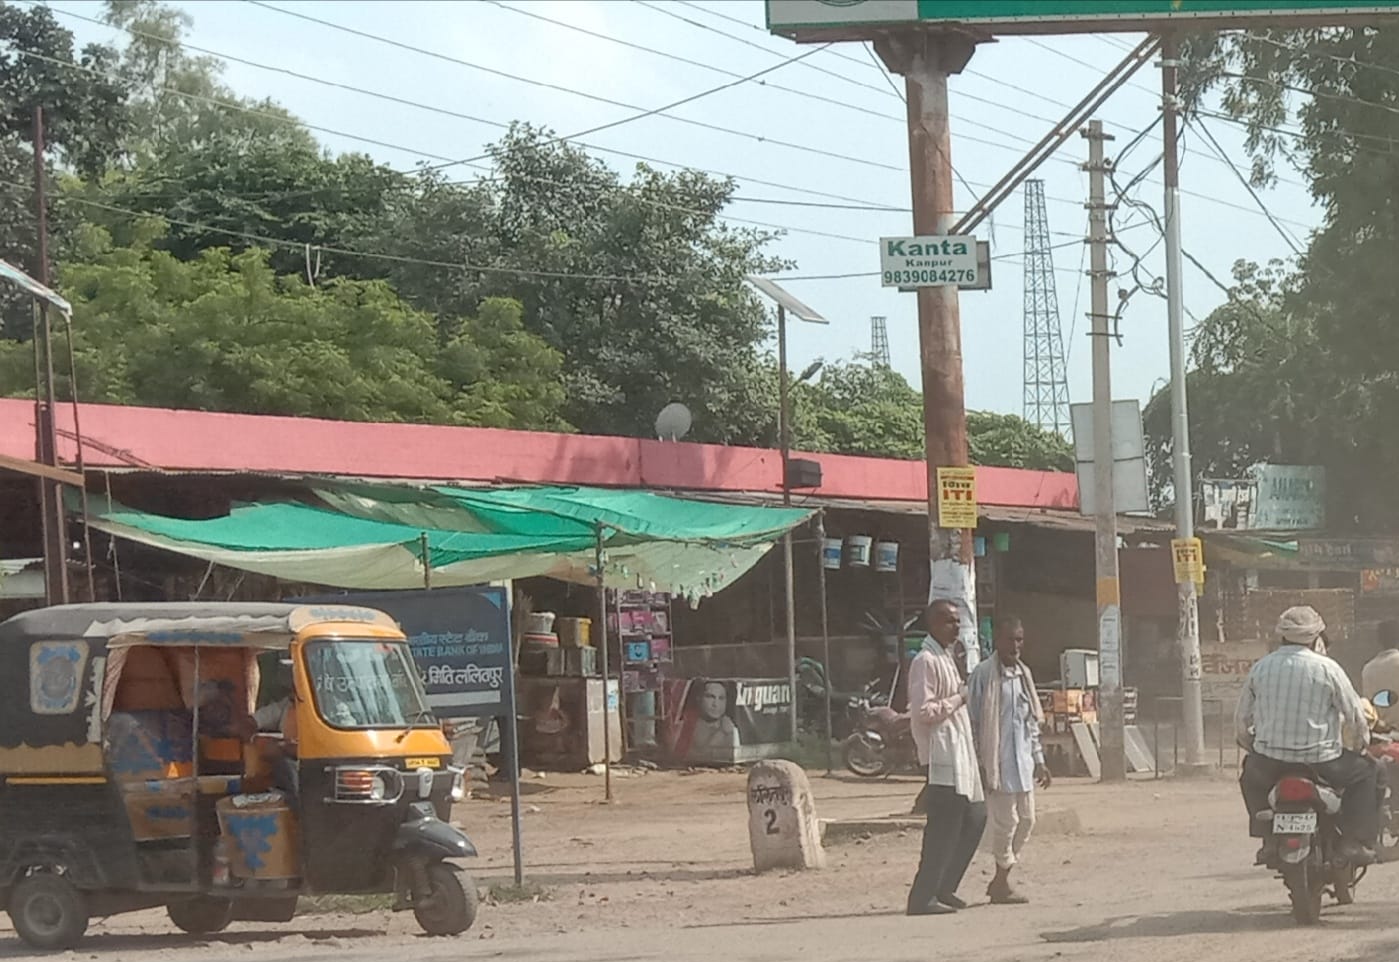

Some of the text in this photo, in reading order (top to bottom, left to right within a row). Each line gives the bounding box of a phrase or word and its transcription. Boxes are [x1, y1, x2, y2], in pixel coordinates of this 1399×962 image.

[887, 240, 967, 256] Kanta
[905, 259, 953, 267] Kanpur
[884, 269, 975, 283] 9839084276
[943, 489, 973, 500] ITI
[438, 645, 465, 656] BANK
[466, 644, 478, 655] OF
[764, 808, 780, 835] 2
